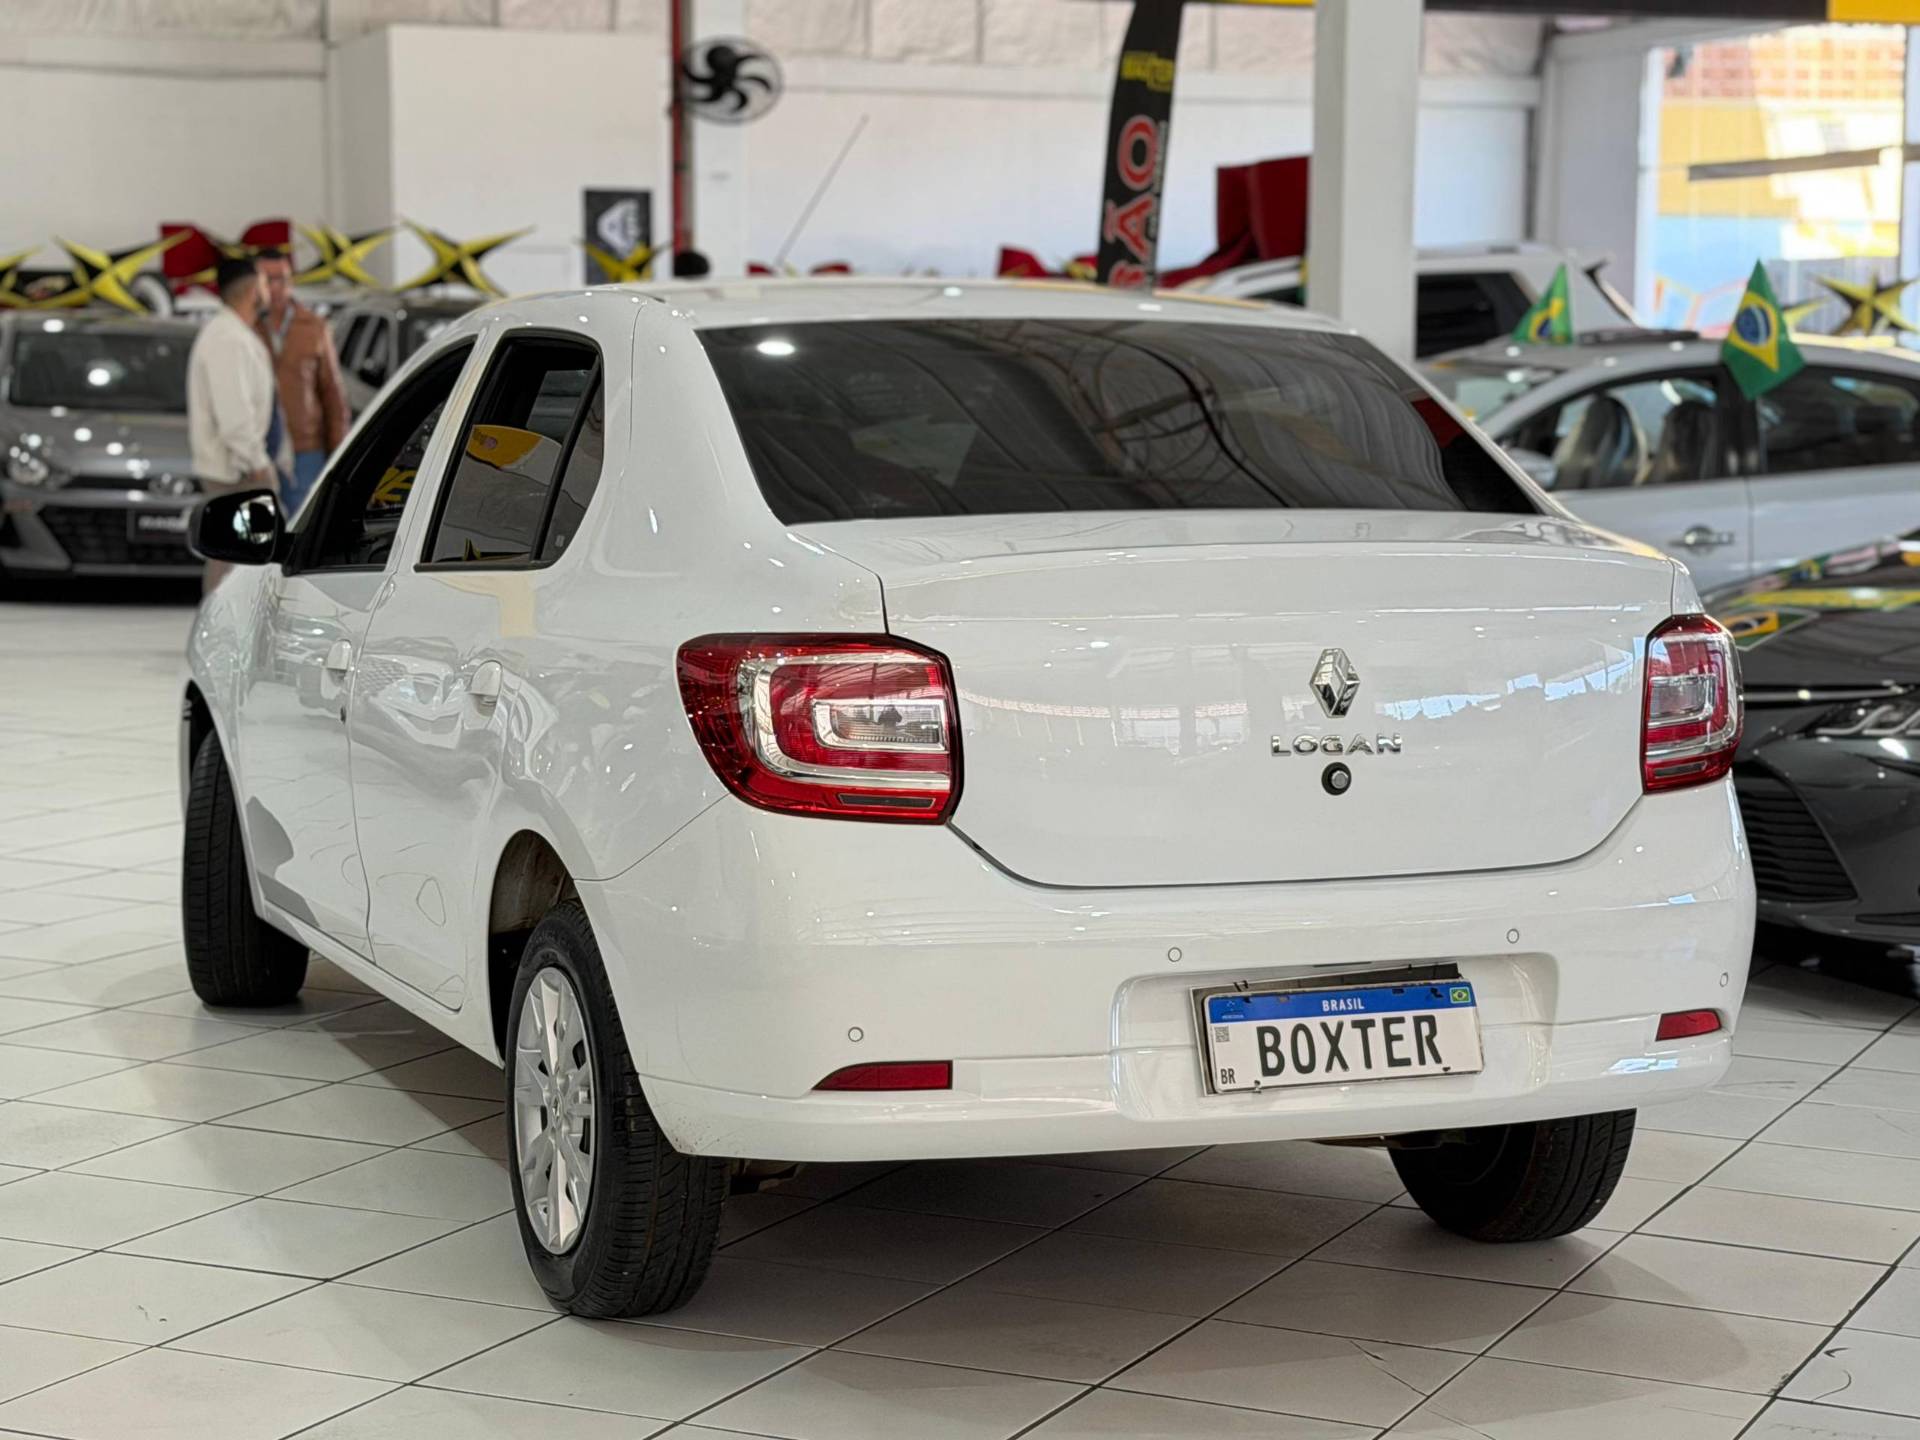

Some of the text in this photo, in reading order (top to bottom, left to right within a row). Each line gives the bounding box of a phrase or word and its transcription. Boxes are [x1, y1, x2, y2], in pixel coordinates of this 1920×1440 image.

[1271, 733, 1403, 757] LOGAN
[1322, 997, 1365, 1013] BRASIL
[1256, 1014, 1443, 1077] BOXTER
[1220, 1068, 1235, 1085] BR
